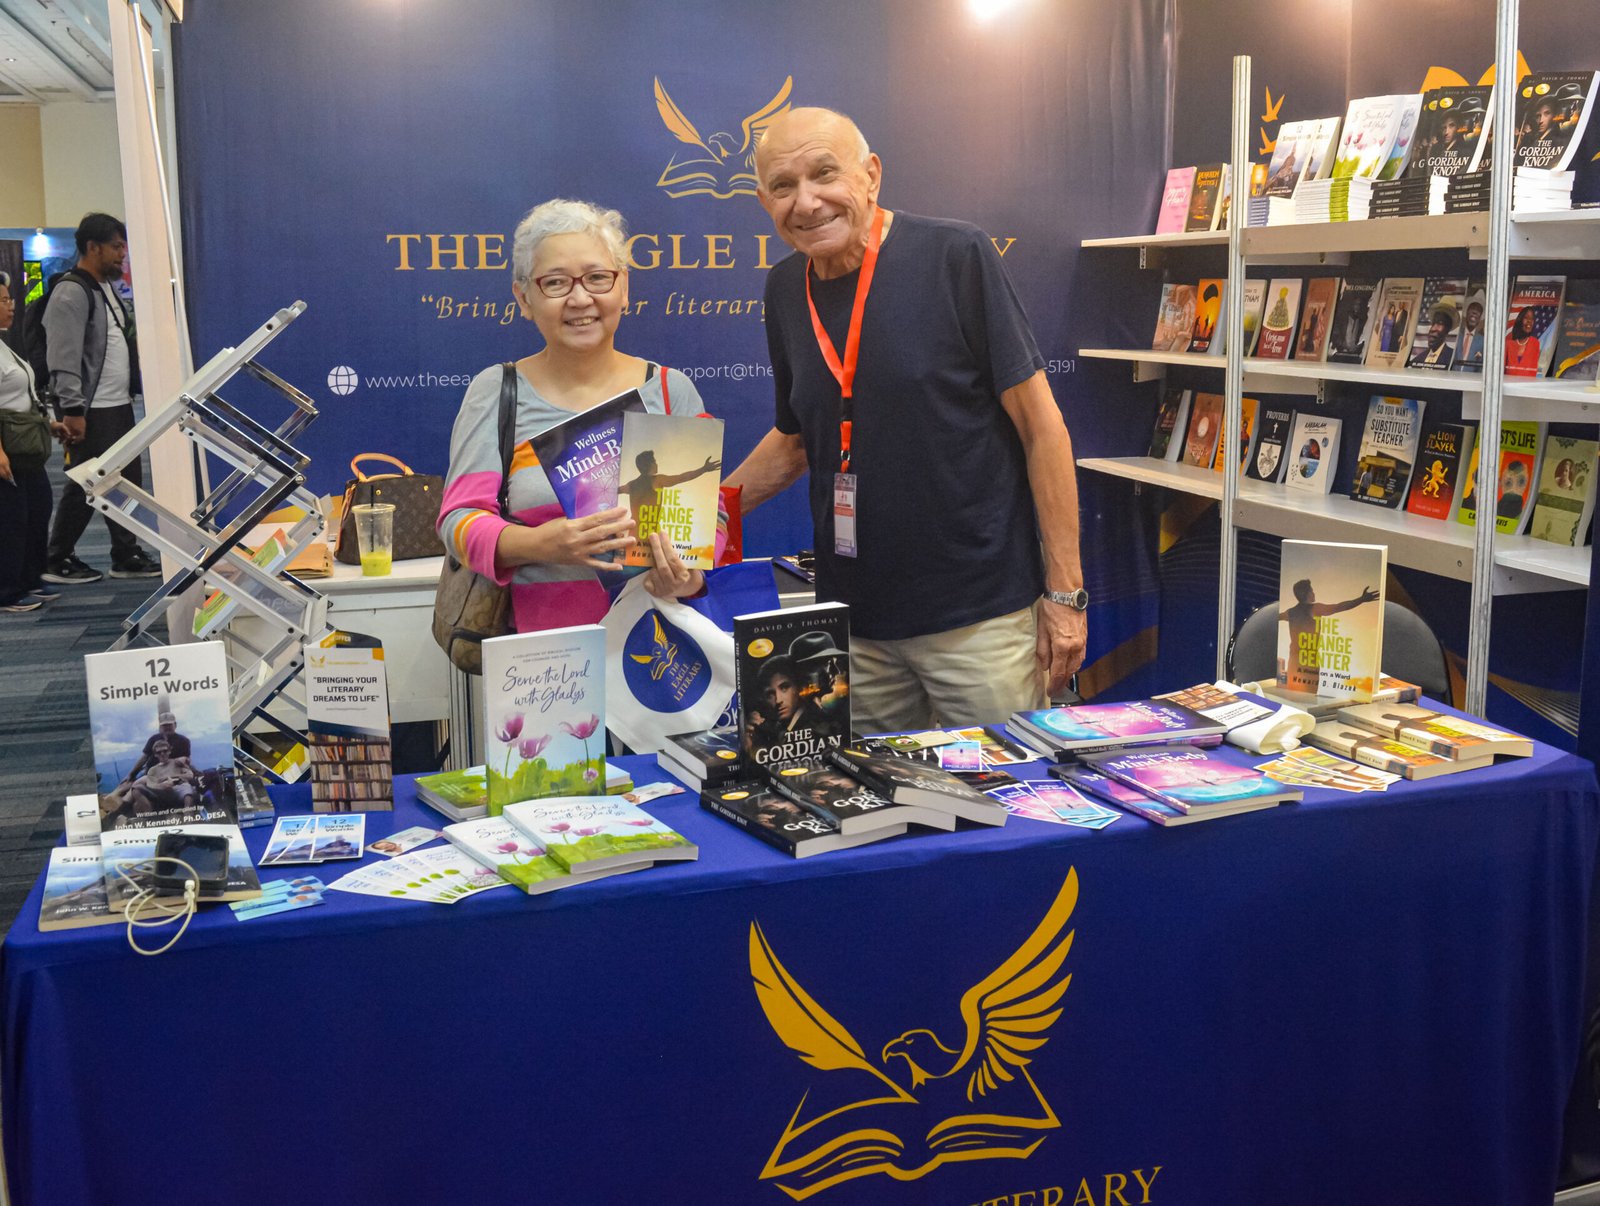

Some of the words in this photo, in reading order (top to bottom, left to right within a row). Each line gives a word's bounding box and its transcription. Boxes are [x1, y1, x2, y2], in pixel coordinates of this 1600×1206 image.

[1444, 150, 1458, 158] THE
[1519, 146, 1564, 157] GORDIAN
[1428, 156, 1470, 167] GORDIAN
[1431, 165, 1461, 176] KNOT
[1522, 156, 1553, 167] KNOT
[386, 234, 509, 271] THE
[625, 234, 736, 270] GLE
[1518, 290, 1556, 298] AMERICA
[421, 294, 523, 325] “Bring
[364, 371, 477, 390] www.theea
[1376, 404, 1385, 414] SO
[1384, 405, 1395, 416] YOU
[1395, 407, 1409, 417] WANT
[1370, 418, 1411, 436] SUBSTITUTE
[574, 426, 616, 451] Wellness
[1373, 431, 1405, 447] TEACHER
[1437, 431, 1457, 442] LION
[1500, 429, 1518, 446] ST'S
[1517, 430, 1536, 449] LIFE
[1425, 439, 1456, 454] SLAYER
[555, 438, 622, 483] Mind-B
[655, 488, 682, 506] THE
[638, 504, 694, 525] CHANGE
[753, 624, 783, 634] DAVID
[801, 617, 839, 627] THOMAS
[1312, 616, 1341, 635] THE
[1297, 632, 1353, 655] CHANGE
[145, 658, 171, 678] 12
[1298, 649, 1352, 672] CENTER
[313, 676, 354, 684] "BRINGING
[502, 666, 542, 692] Serve
[543, 666, 561, 685] the
[561, 659, 591, 684] Lord
[671, 663, 690, 689] EAGLE
[673, 661, 702, 702] LITERARY
[1334, 672, 1351, 680] Ward
[100, 682, 159, 701] Simple
[163, 676, 219, 694] Words
[1332, 681, 1356, 691] Blazek
[514, 687, 539, 707] with
[540, 682, 585, 713] Gladys
[784, 728, 812, 743] THE
[755, 735, 842, 765] GORDIAN
[1106, 752, 1209, 770] Mind-Body
[169, 806, 197, 815] Compiled
[710, 801, 719, 810] THE
[719, 806, 737, 820] GORDIAN
[736, 815, 748, 827] KNOT
[134, 822, 145, 830] W.
[146, 817, 182, 827] Kennedy,
[207, 811, 227, 820] DESA
[113, 838, 157, 846] Simp
[61, 855, 101, 864] Simp
